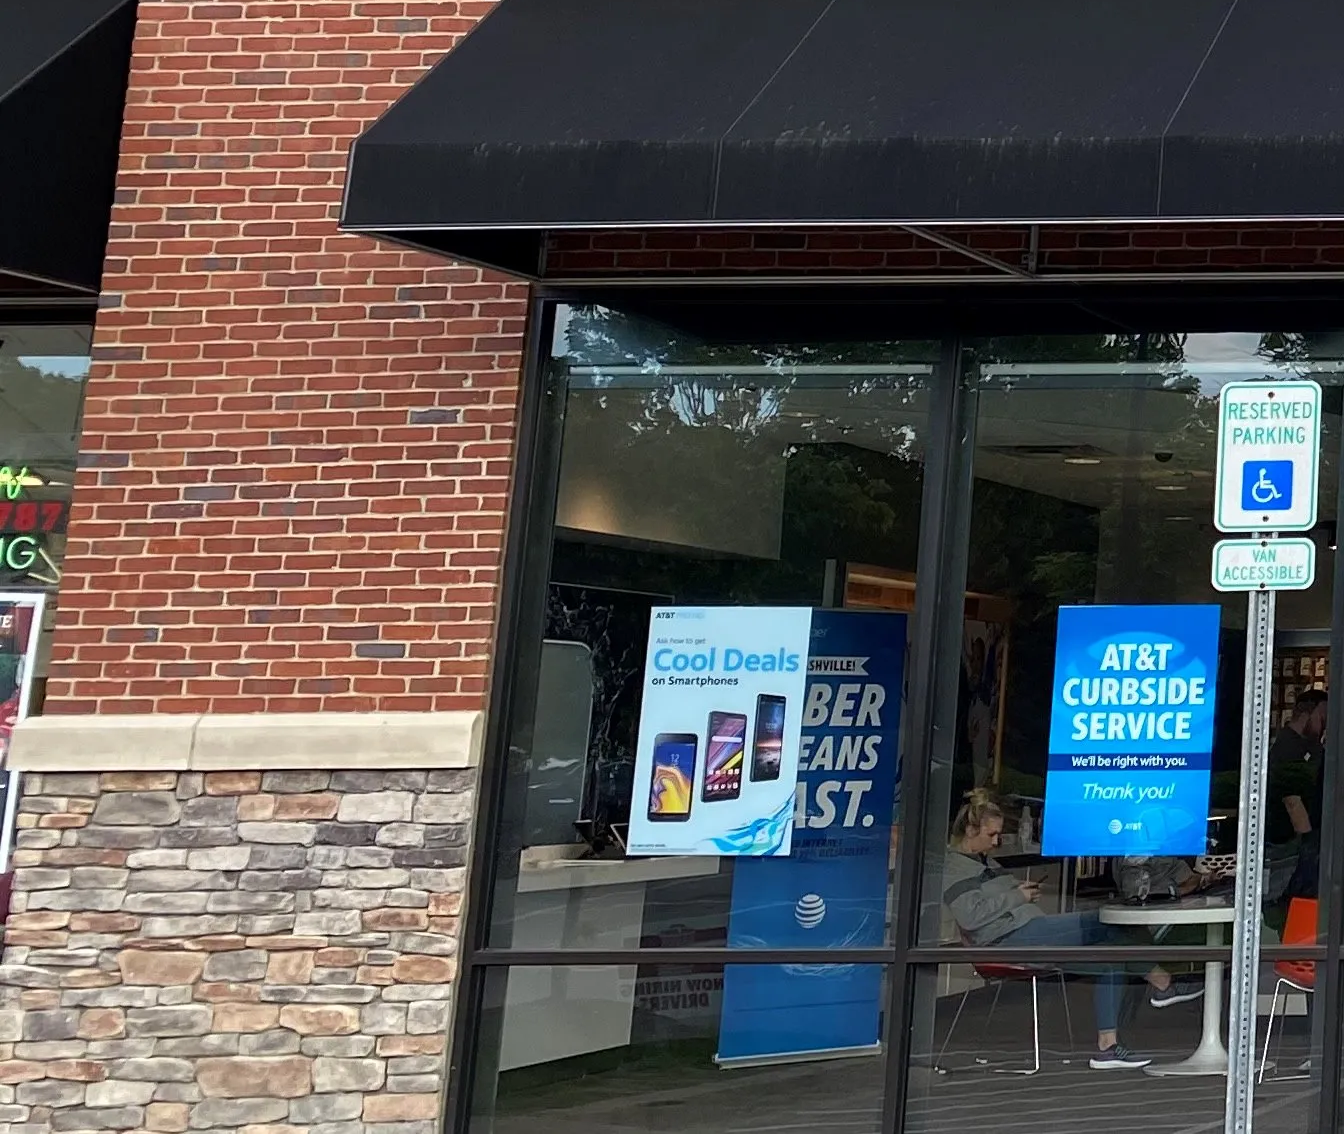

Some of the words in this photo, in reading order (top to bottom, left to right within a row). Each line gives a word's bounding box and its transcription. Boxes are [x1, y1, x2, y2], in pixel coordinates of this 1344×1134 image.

[1228, 401, 1313, 420] RESERVED
[1232, 426, 1306, 445] PARKING
[1252, 548, 1277, 563] VAN
[1223, 565, 1304, 581] ACCESSIBLE
[655, 611, 675, 619] AT&T
[654, 646, 717, 672] Cool
[723, 647, 800, 672] Deals
[809, 659, 857, 672] SHVILLE!
[1100, 643, 1173, 671] AT&T
[651, 677, 666, 686] on
[668, 675, 739, 688] Smartphones
[1062, 677, 1207, 706] CURBSIDE
[801, 683, 886, 727] BER
[1071, 711, 1193, 741] SERVICE
[797, 735, 883, 771] EANS
[1071, 756, 1096, 767] We'll
[1097, 756, 1111, 767] be
[1112, 755, 1139, 769] right
[1140, 755, 1164, 766] with
[1164, 756, 1188, 769] you.
[1082, 782, 1135, 800] Thank
[1135, 782, 1177, 804] you!
[793, 780, 875, 829] AST.
[1124, 823, 1143, 831] AT&T
